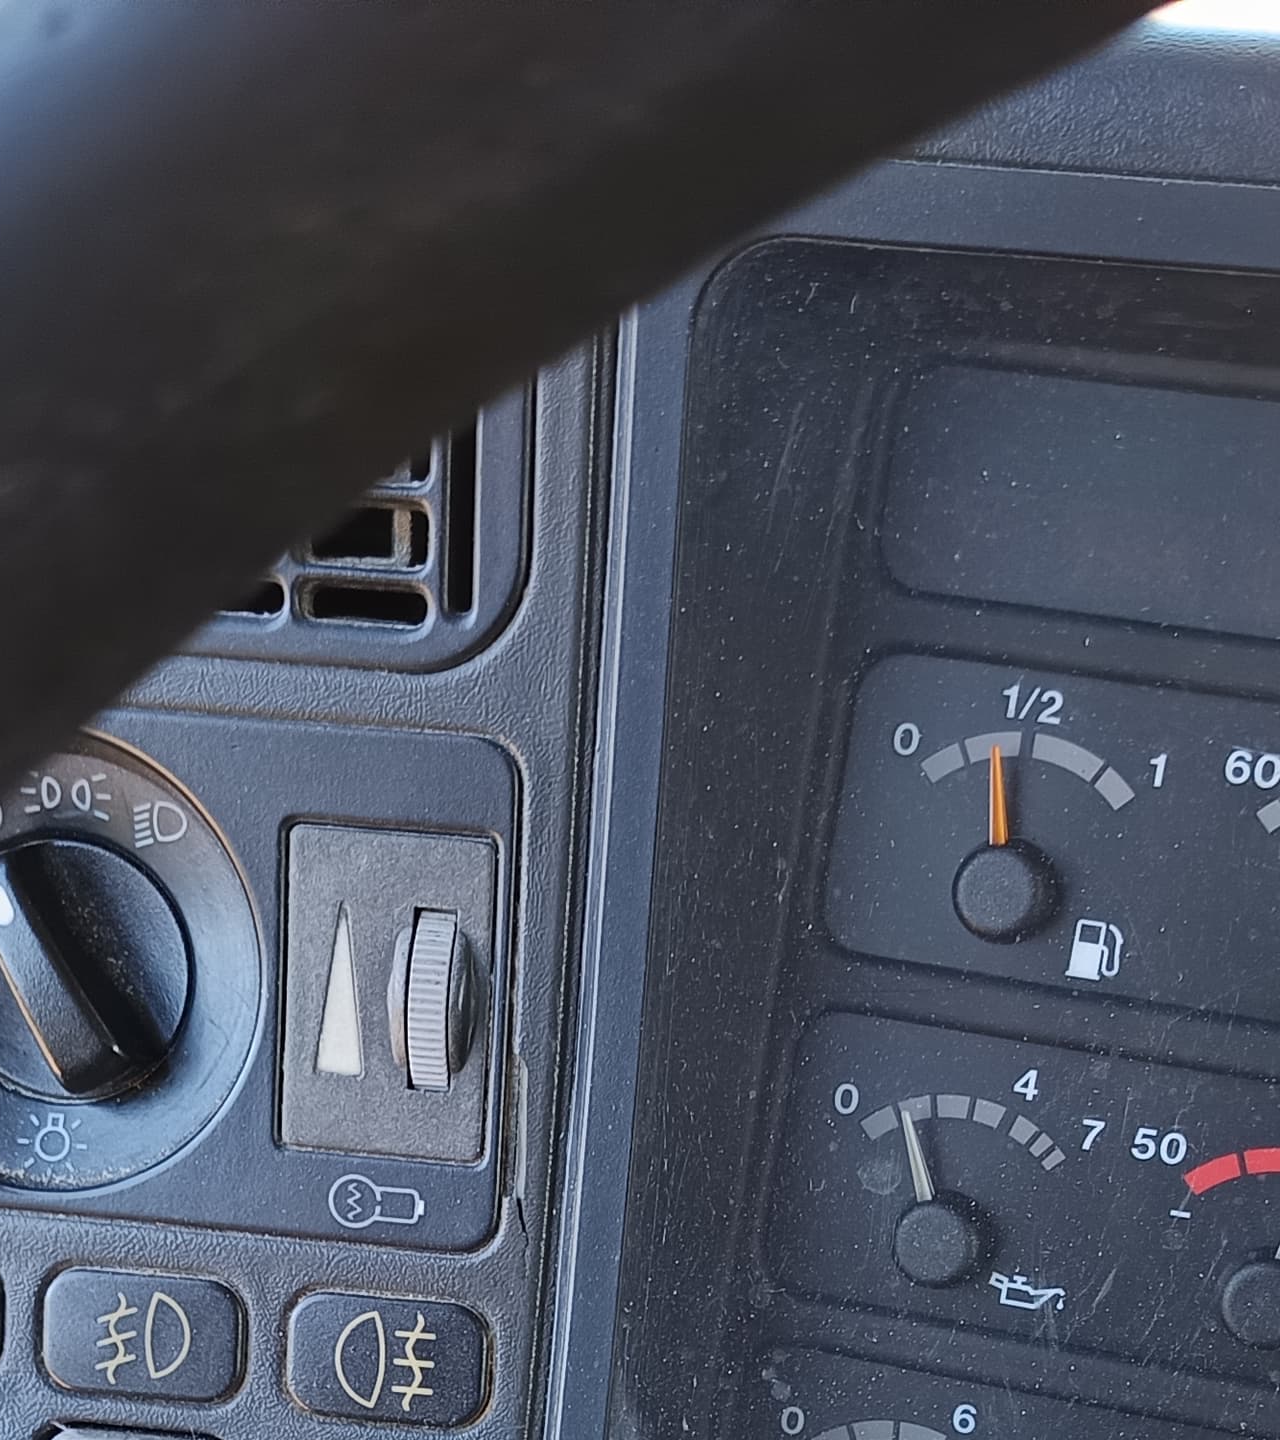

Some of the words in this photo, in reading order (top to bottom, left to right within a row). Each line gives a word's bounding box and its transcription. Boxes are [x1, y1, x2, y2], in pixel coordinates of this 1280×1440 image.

[1001, 682, 1065, 726] 1/2
[892, 721, 924, 757] 0
[1148, 752, 1169, 789] 1
[833, 1082, 860, 1116] 0
[1012, 1068, 1040, 1102] 4
[1080, 1117, 1107, 1152] 7
[1130, 1126, 1188, 1166] 50
[779, 1405, 806, 1437] 0
[951, 1403, 978, 1435] 6
